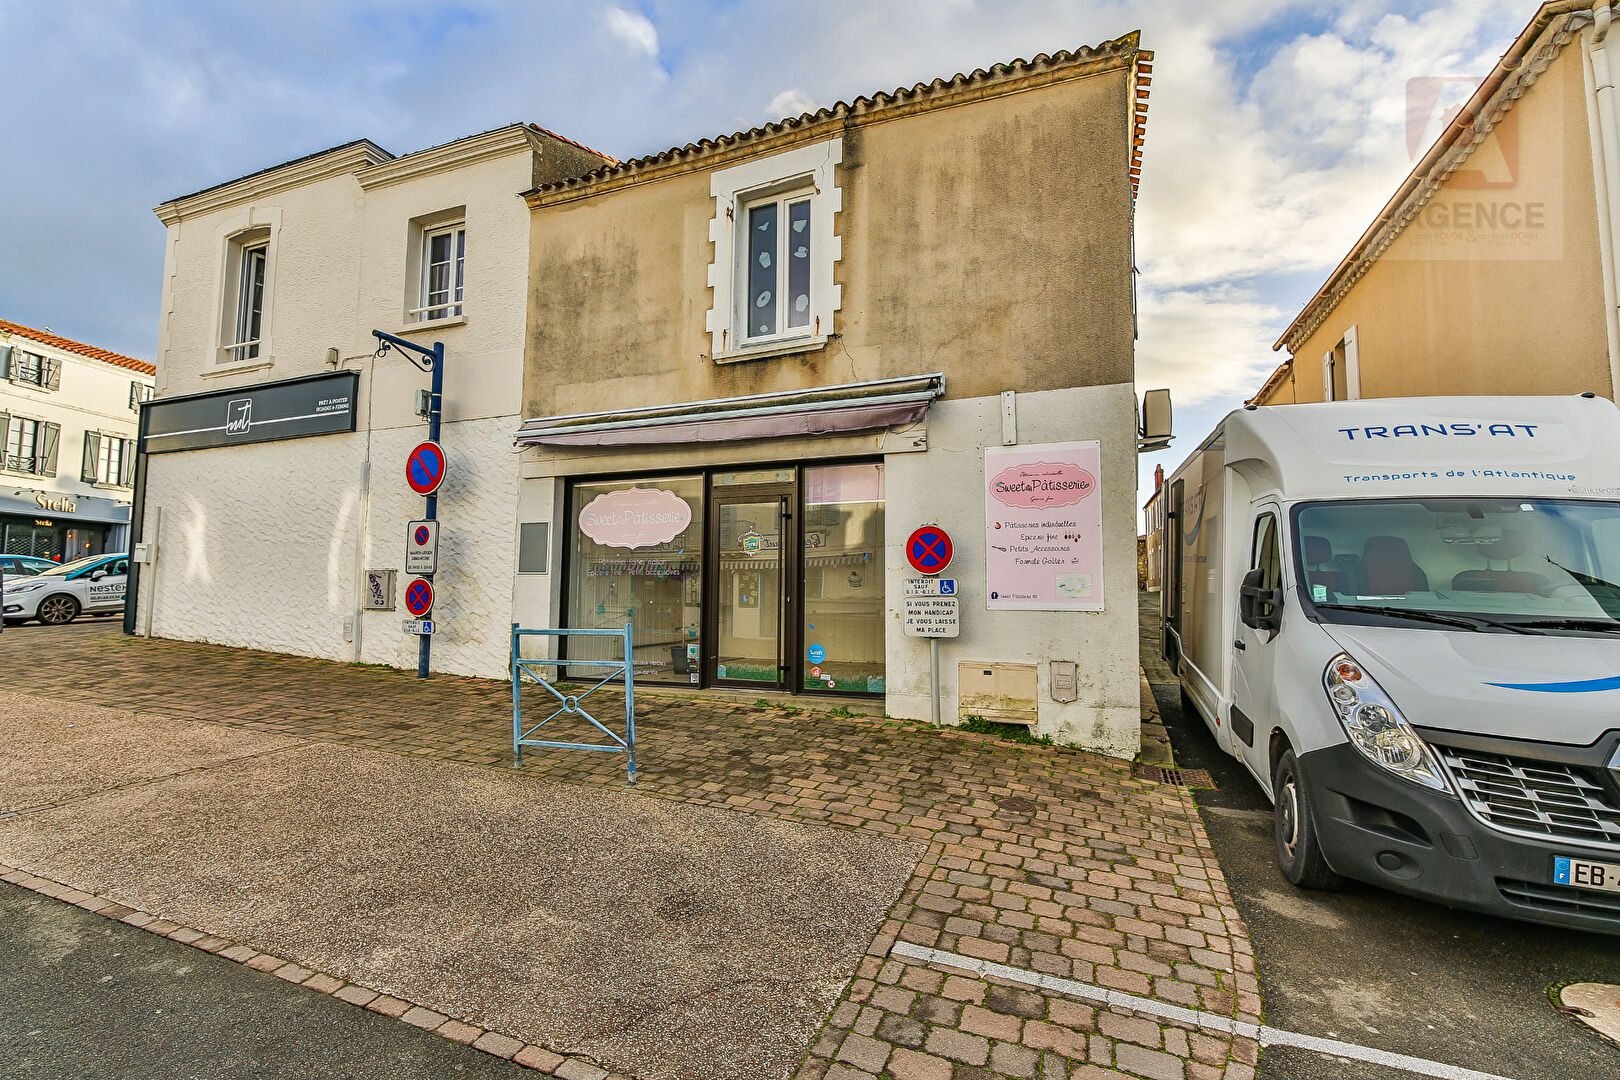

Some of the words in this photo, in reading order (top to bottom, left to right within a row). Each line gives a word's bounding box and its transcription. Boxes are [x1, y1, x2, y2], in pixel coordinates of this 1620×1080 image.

[1338, 423, 1539, 441] TRANS'AT
[1343, 471, 1438, 483] Transports
[1446, 470, 1465, 478] de
[1472, 469, 1576, 482] l'Atlantique
[996, 481, 1026, 493] Sweet
[1031, 479, 1086, 493] Pâtisserie
[35, 494, 77, 513] Stella
[34, 519, 53, 527] Stella
[584, 511, 617, 527] Sweet
[623, 510, 681, 525] Pâtisserie
[1575, 863, 1620, 887] EB-
